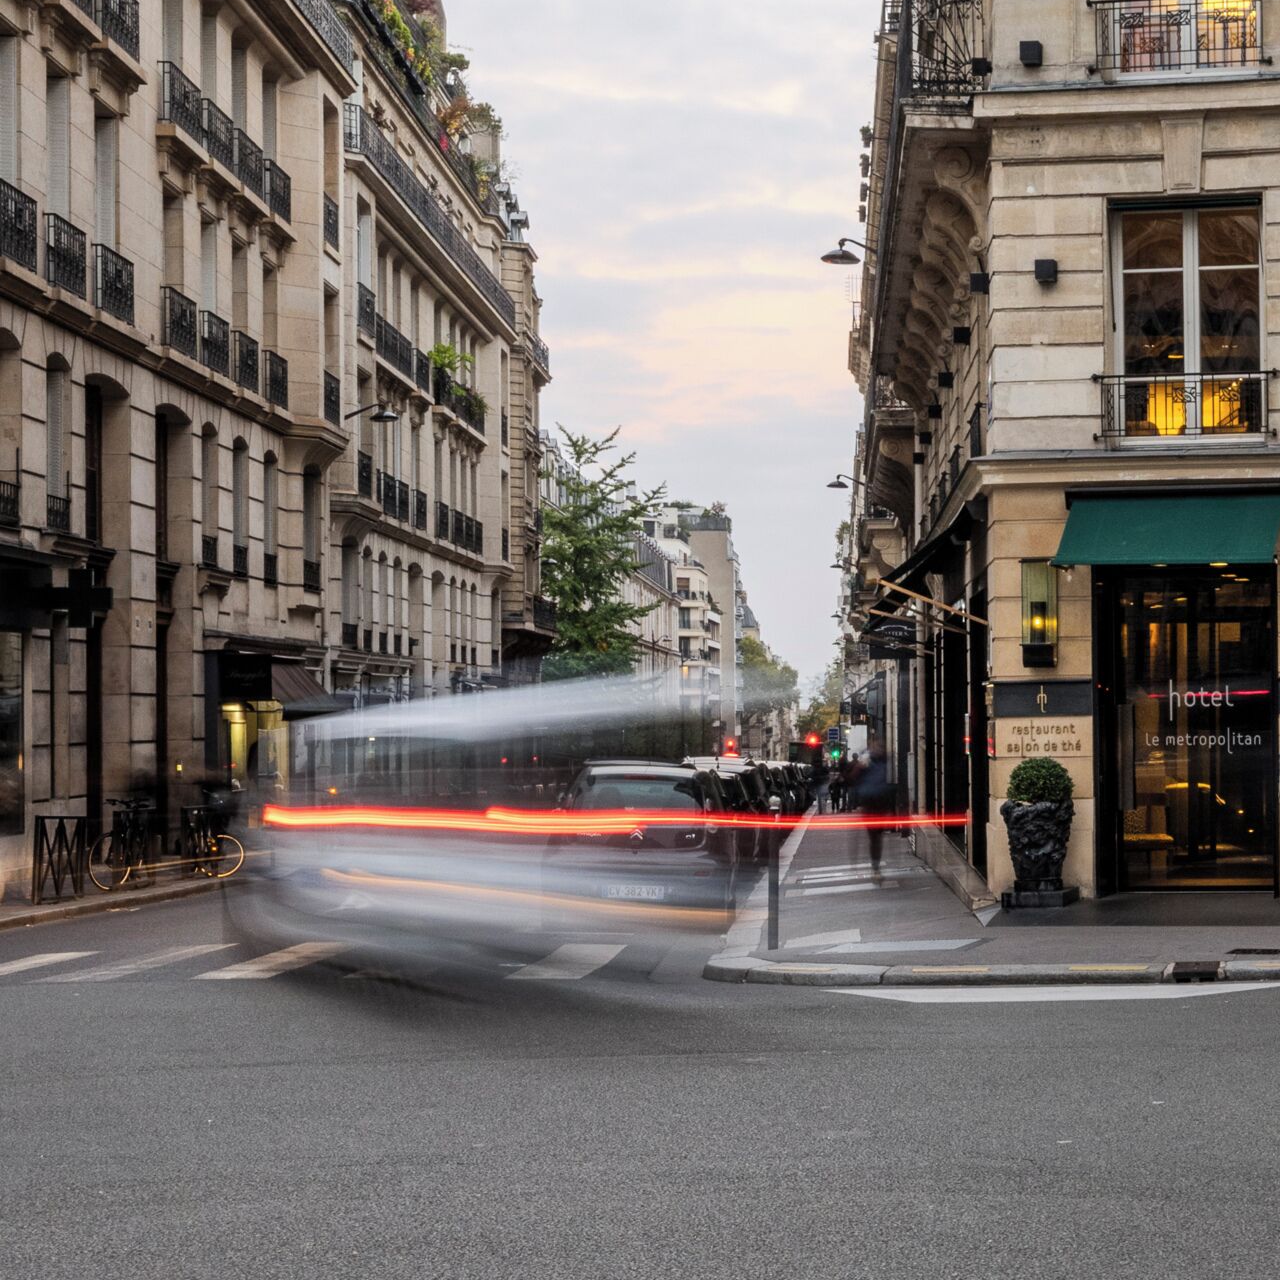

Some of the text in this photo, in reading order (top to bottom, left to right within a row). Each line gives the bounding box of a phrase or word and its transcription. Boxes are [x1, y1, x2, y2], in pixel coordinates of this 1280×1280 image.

[1168, 679, 1235, 721] hotel
[1011, 720, 1077, 741] restaurant
[1145, 727, 1262, 754] le metropolitan
[1006, 736, 1082, 758] salon de thé
